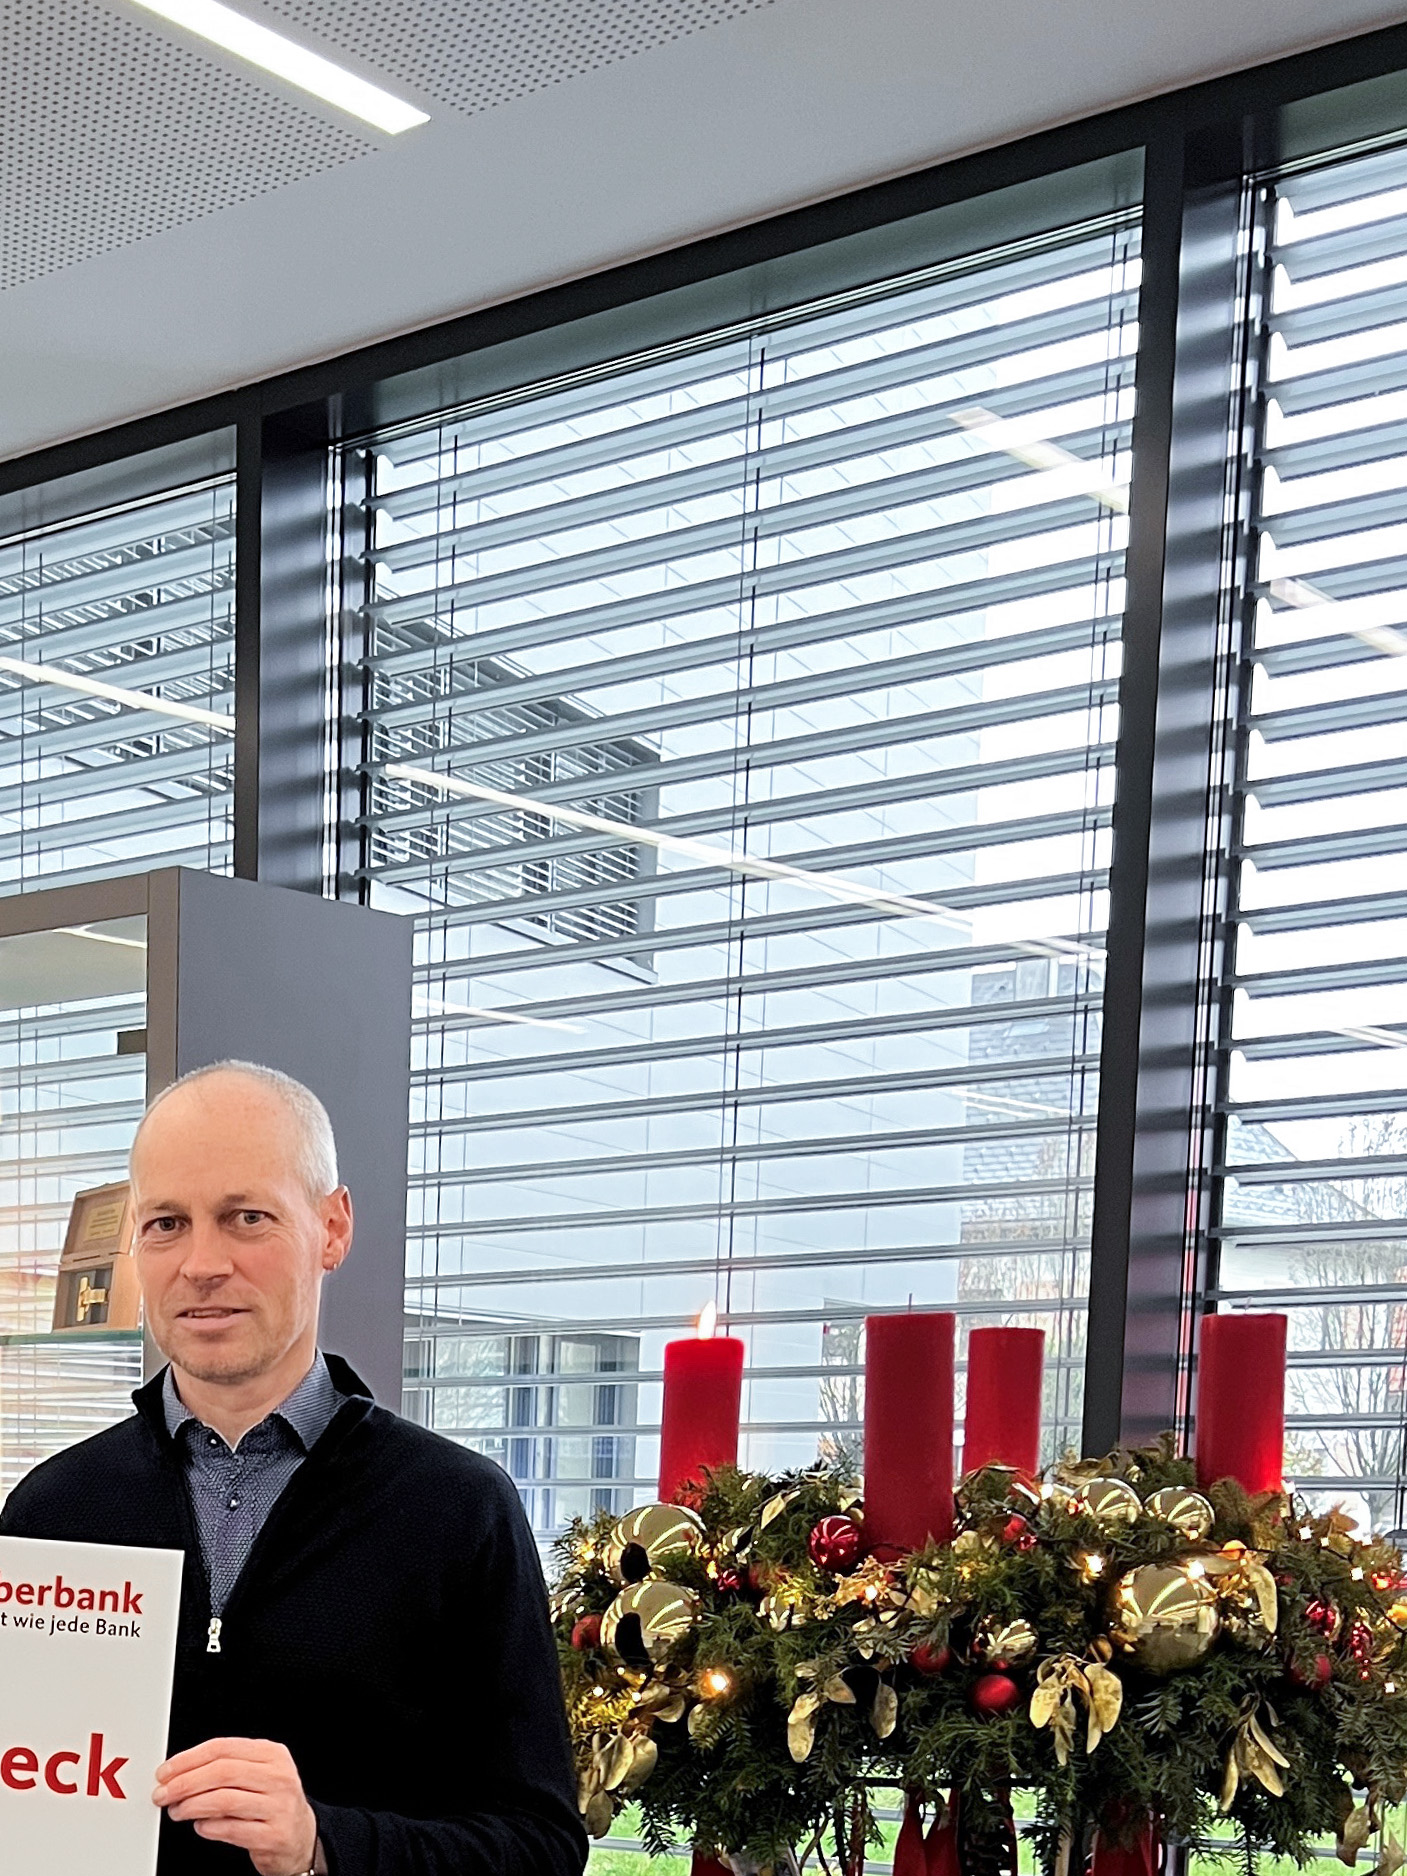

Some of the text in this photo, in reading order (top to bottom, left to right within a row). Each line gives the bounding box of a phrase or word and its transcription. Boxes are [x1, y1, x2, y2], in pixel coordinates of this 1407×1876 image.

[13, 1612, 45, 1630] wie
[48, 1614, 90, 1636] jede
[95, 1618, 141, 1638] Bank
